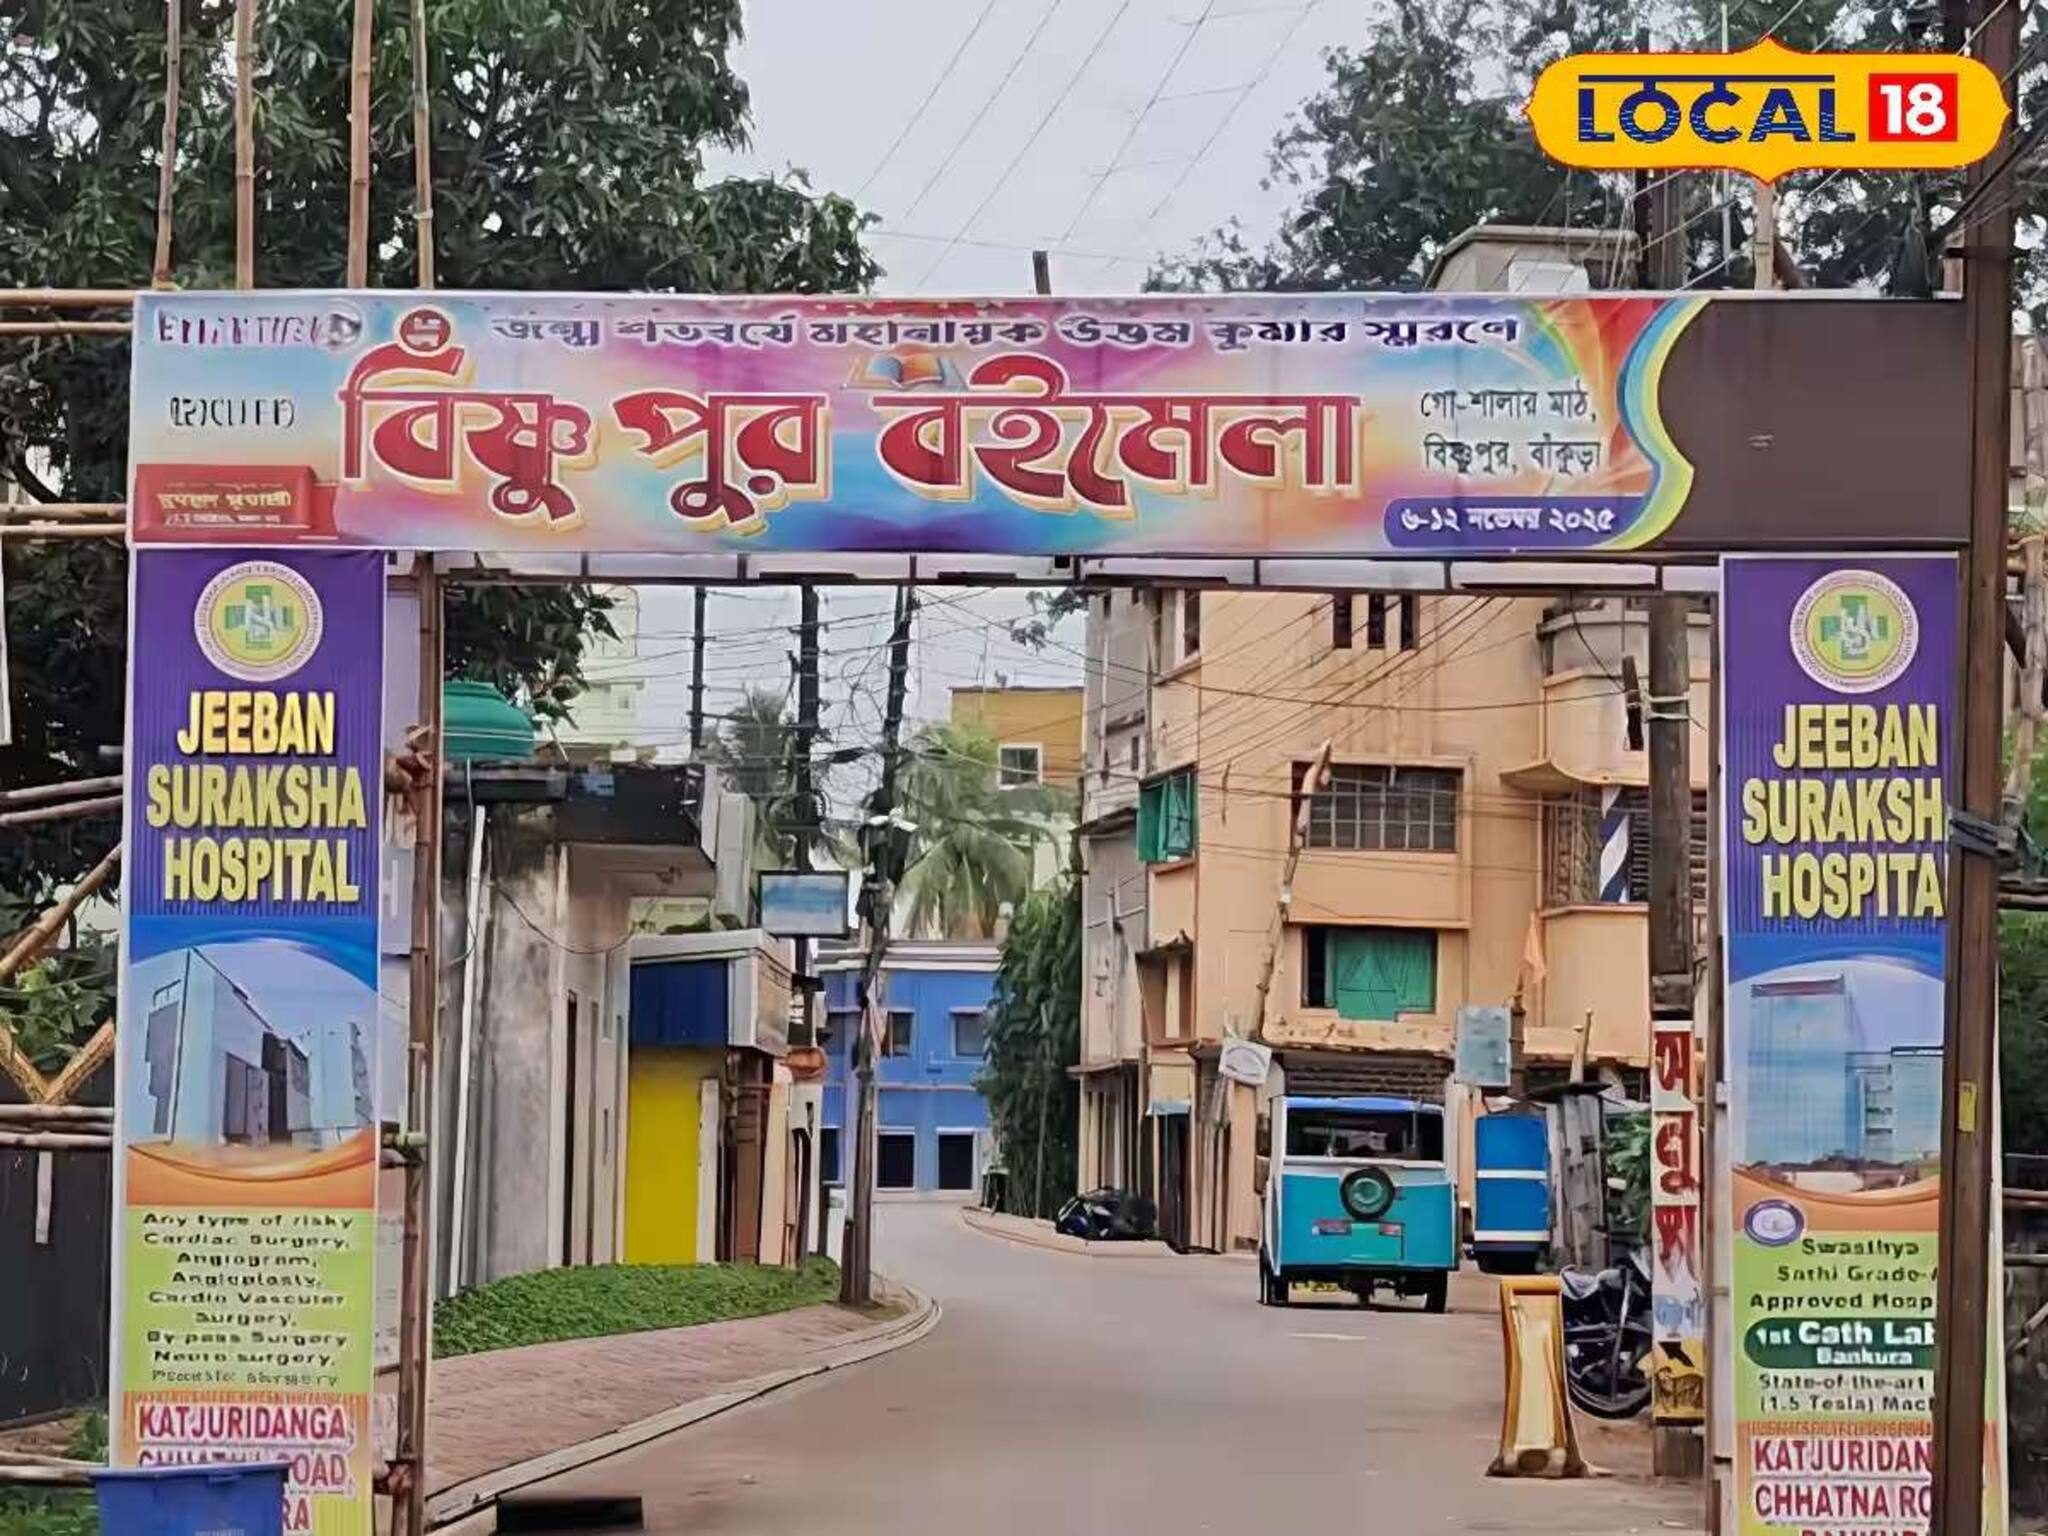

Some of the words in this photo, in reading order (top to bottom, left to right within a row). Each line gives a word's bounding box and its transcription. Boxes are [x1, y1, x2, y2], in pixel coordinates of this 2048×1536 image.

[1059, 316, 1191, 345] উত্তম
[1208, 319, 1347, 350] কুমার
[1363, 317, 1520, 348] স্মরণে
[1401, 507, 1462, 532] ৬-১২
[1549, 507, 1615, 533] ২০২৫
[177, 690, 336, 756] JEEBAN
[1773, 703, 1938, 769] JEEBAN
[146, 763, 368, 829] SURAKSHA
[1741, 776, 1944, 845] SURAKSH
[163, 836, 361, 903] HOSPITAL
[1761, 851, 1945, 920] HOSPITA
[143, 1213, 188, 1228] Any
[197, 1214, 250, 1229] type
[260, 1214, 283, 1227] of
[292, 1214, 354, 1229] risky
[144, 1232, 238, 1246] Cardiac
[1802, 1238, 1920, 1260] Swasthya
[1776, 1265, 1839, 1282] Sathi
[1749, 1293, 1863, 1311] Approved
[1756, 1327, 1792, 1345] 1st
[1798, 1320, 1874, 1346] Cath
[1816, 1346, 1914, 1366] Bankura
[1760, 1395, 1800, 1412] (1.5
[1811, 1394, 1874, 1413] Tesla)
[1755, 1484, 1890, 1518] CHHATNA
